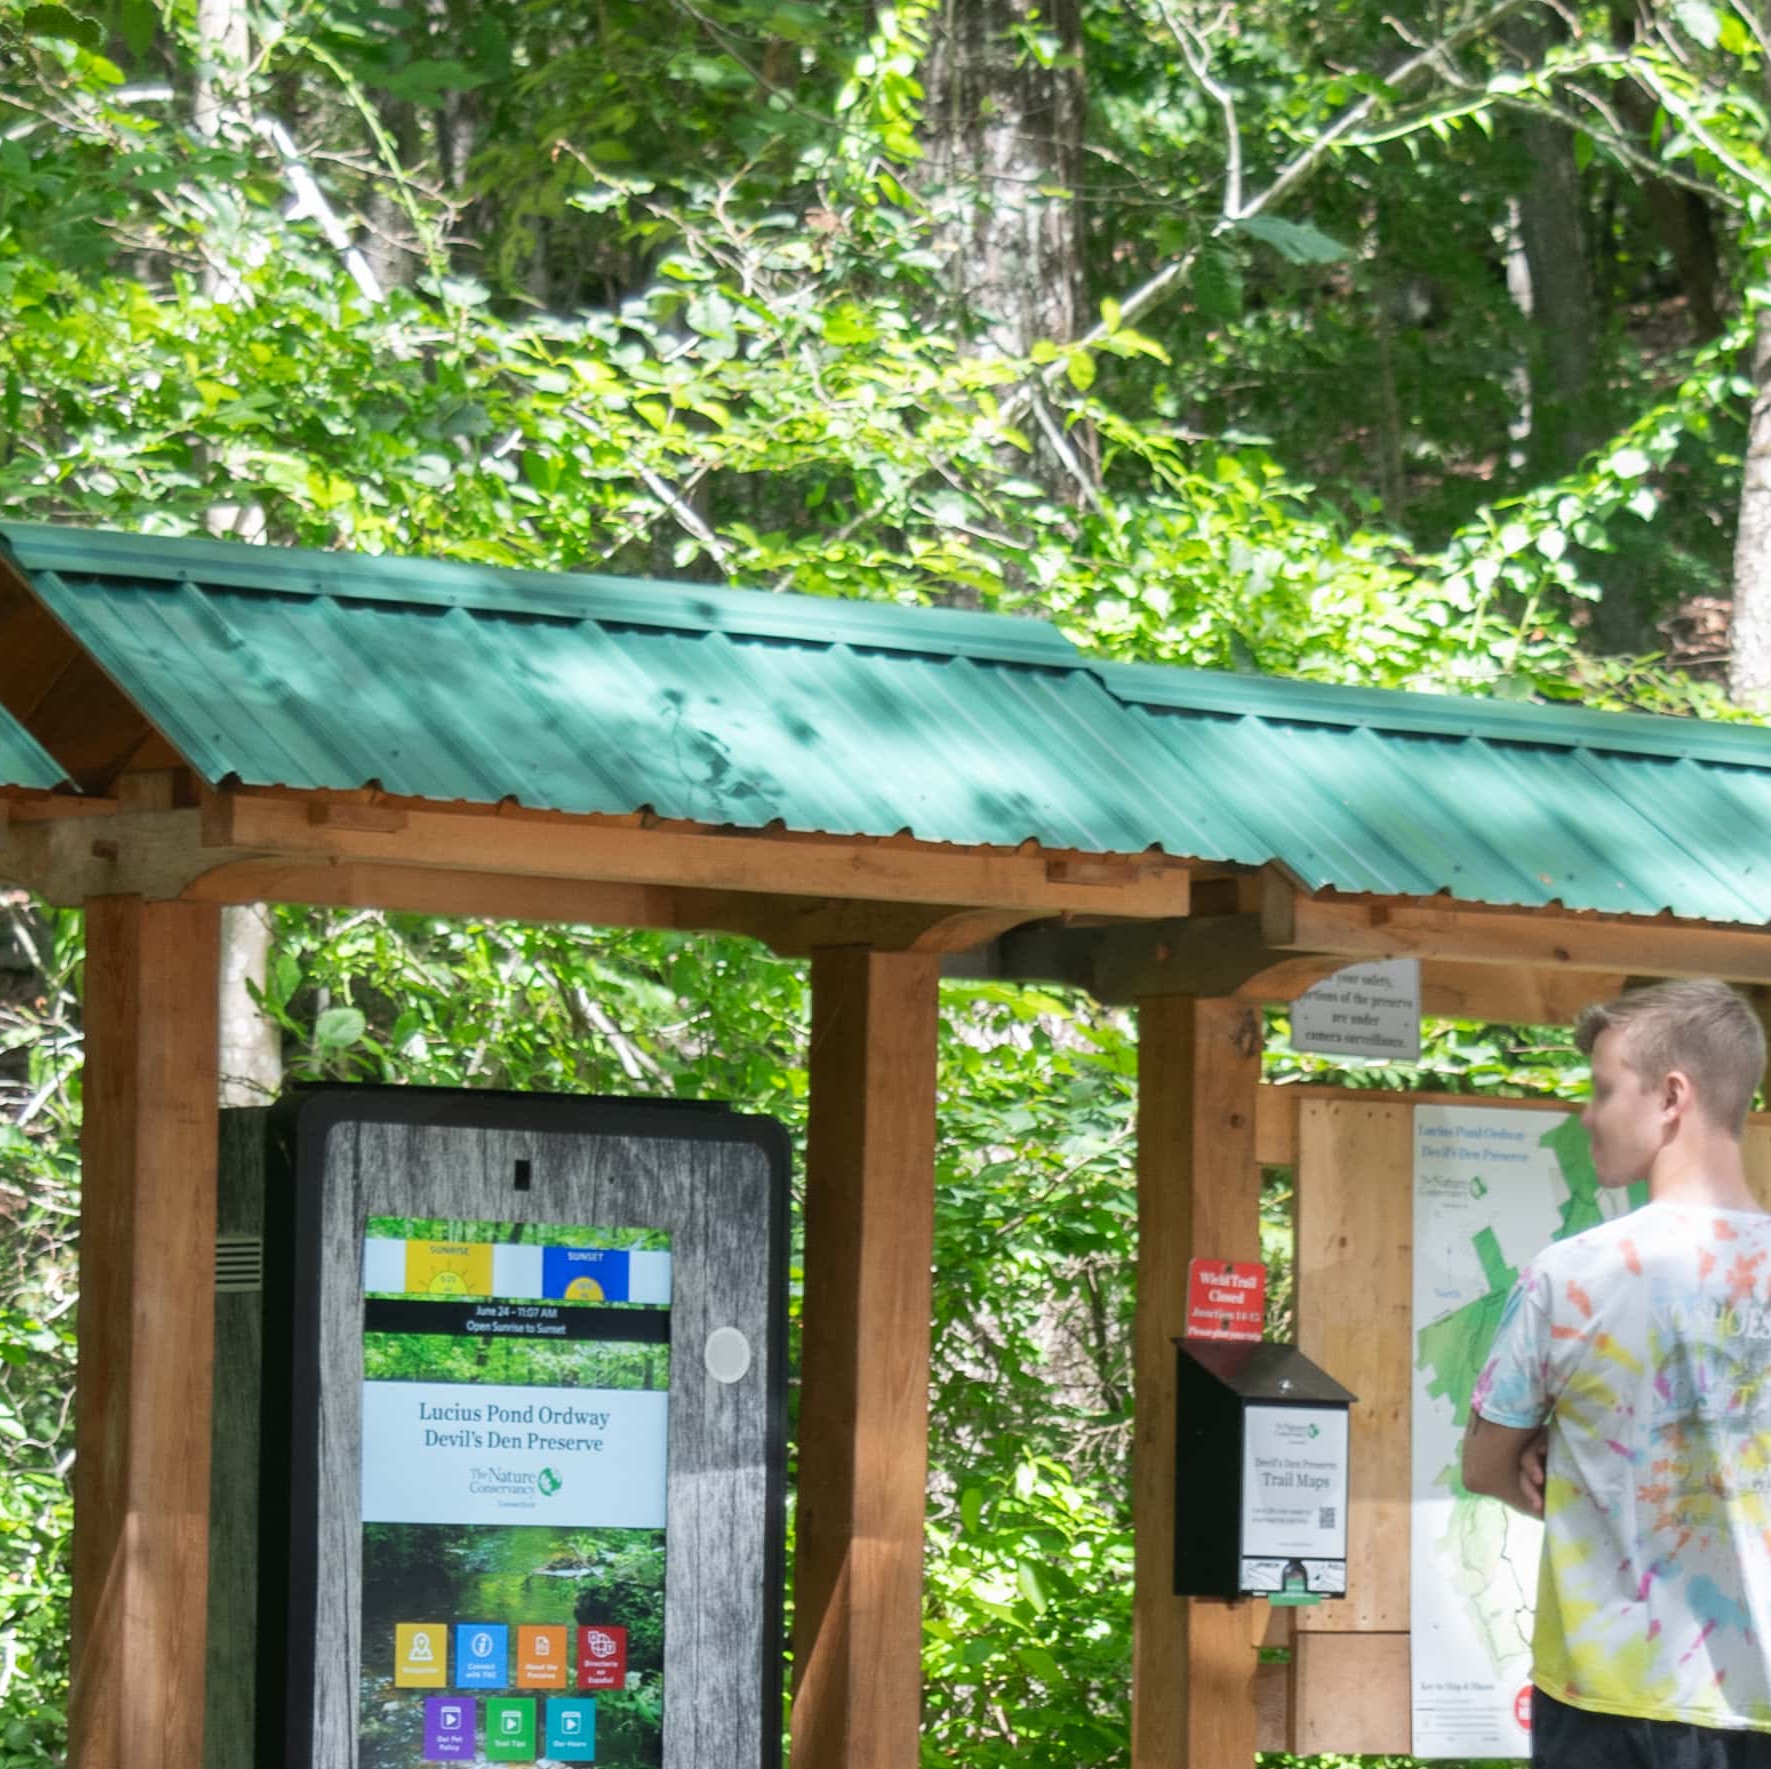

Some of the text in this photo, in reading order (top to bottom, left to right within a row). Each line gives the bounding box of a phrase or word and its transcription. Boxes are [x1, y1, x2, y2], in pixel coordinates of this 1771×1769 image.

[1340, 992, 1413, 1008] of the preserve
[1332, 1013, 1380, 1027] are under
[1305, 1031, 1341, 1043] camera
[1418, 1124, 1525, 1142] Lucius Pond Ordway
[1421, 1145, 1529, 1162] Devil's Den Preserve
[430, 1246, 468, 1256] SUNRISE
[568, 1251, 604, 1262] SUNSET
[1209, 1289, 1245, 1305] Closed
[476, 1305, 496, 1317] June
[541, 1308, 558, 1318] AM
[466, 1320, 566, 1335] Open Sunrise to Sunset
[419, 1402, 611, 1430] Lucius Pond Ordway
[425, 1429, 603, 1451] Devil's Den Preserve
[470, 1467, 536, 1484] The Nature
[1260, 1472, 1330, 1491] Trail Maps
[469, 1482, 536, 1499] Conservancy
